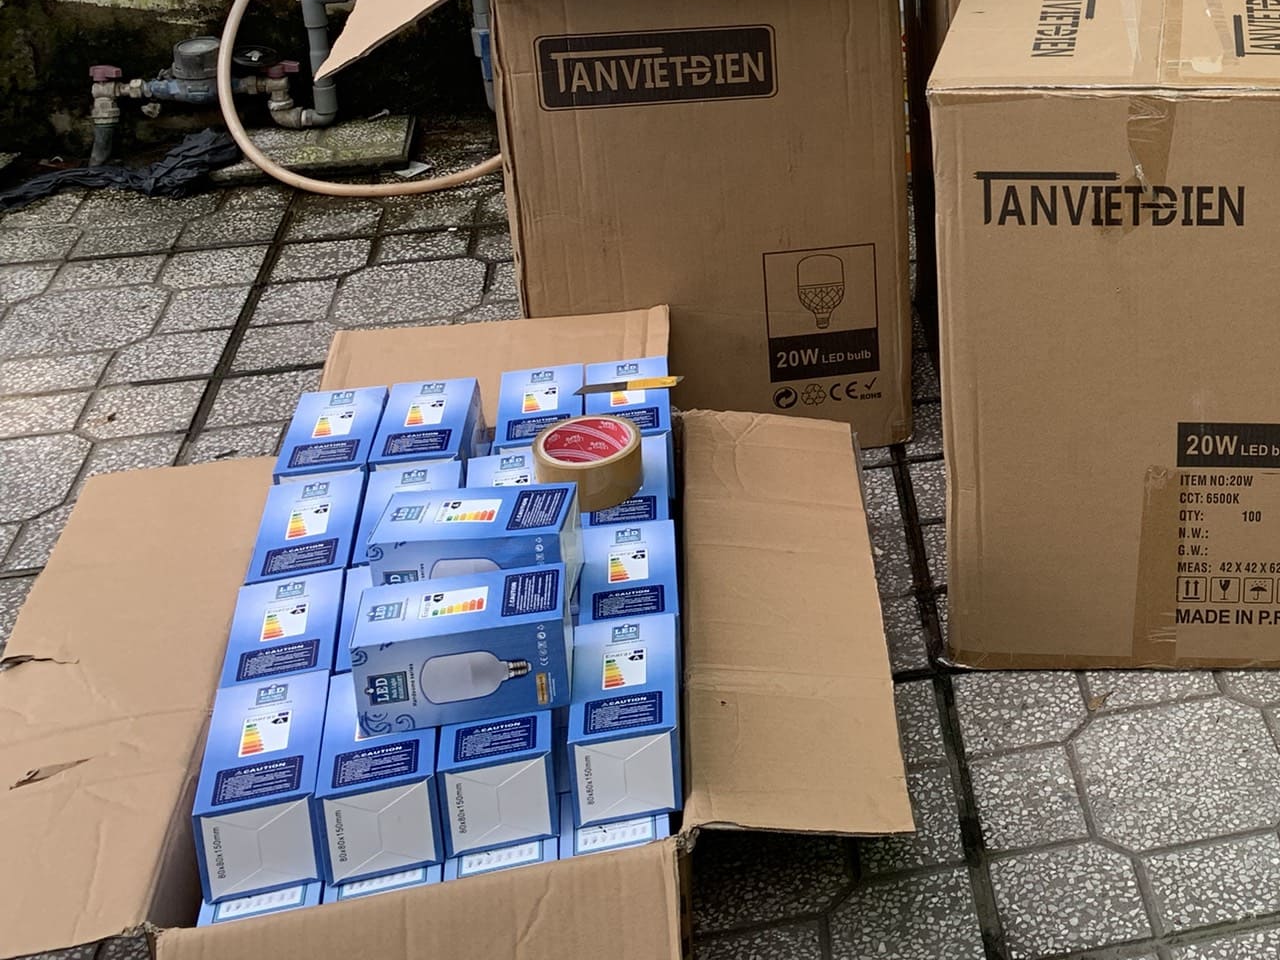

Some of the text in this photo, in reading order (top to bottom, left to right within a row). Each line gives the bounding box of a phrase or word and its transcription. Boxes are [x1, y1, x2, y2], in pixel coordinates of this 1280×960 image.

[777, 348, 872, 369] 20W LED bulb
[1185, 435, 1238, 456] 20W
[1240, 444, 1268, 456] LED
[1180, 475, 1207, 486] ITEM
[1179, 493, 1240, 504] CCT: 6500K
[1179, 510, 1204, 521] QTY:
[1242, 511, 1262, 522] 100
[1178, 527, 1209, 539] N.W.:
[1177, 544, 1208, 556] G.W.:
[1177, 562, 1212, 573] MEAS:
[1219, 562, 1233, 573] 42
[1244, 563, 1258, 573] 42
[1175, 608, 1231, 624] MADE
[1235, 609, 1253, 625] IN
[375, 677, 390, 703] LED
[608, 695, 648, 707] CAUTION
[480, 721, 522, 734] CAUTION
[360, 744, 404, 759] CAUTION
[242, 761, 287, 776] CAUTION
